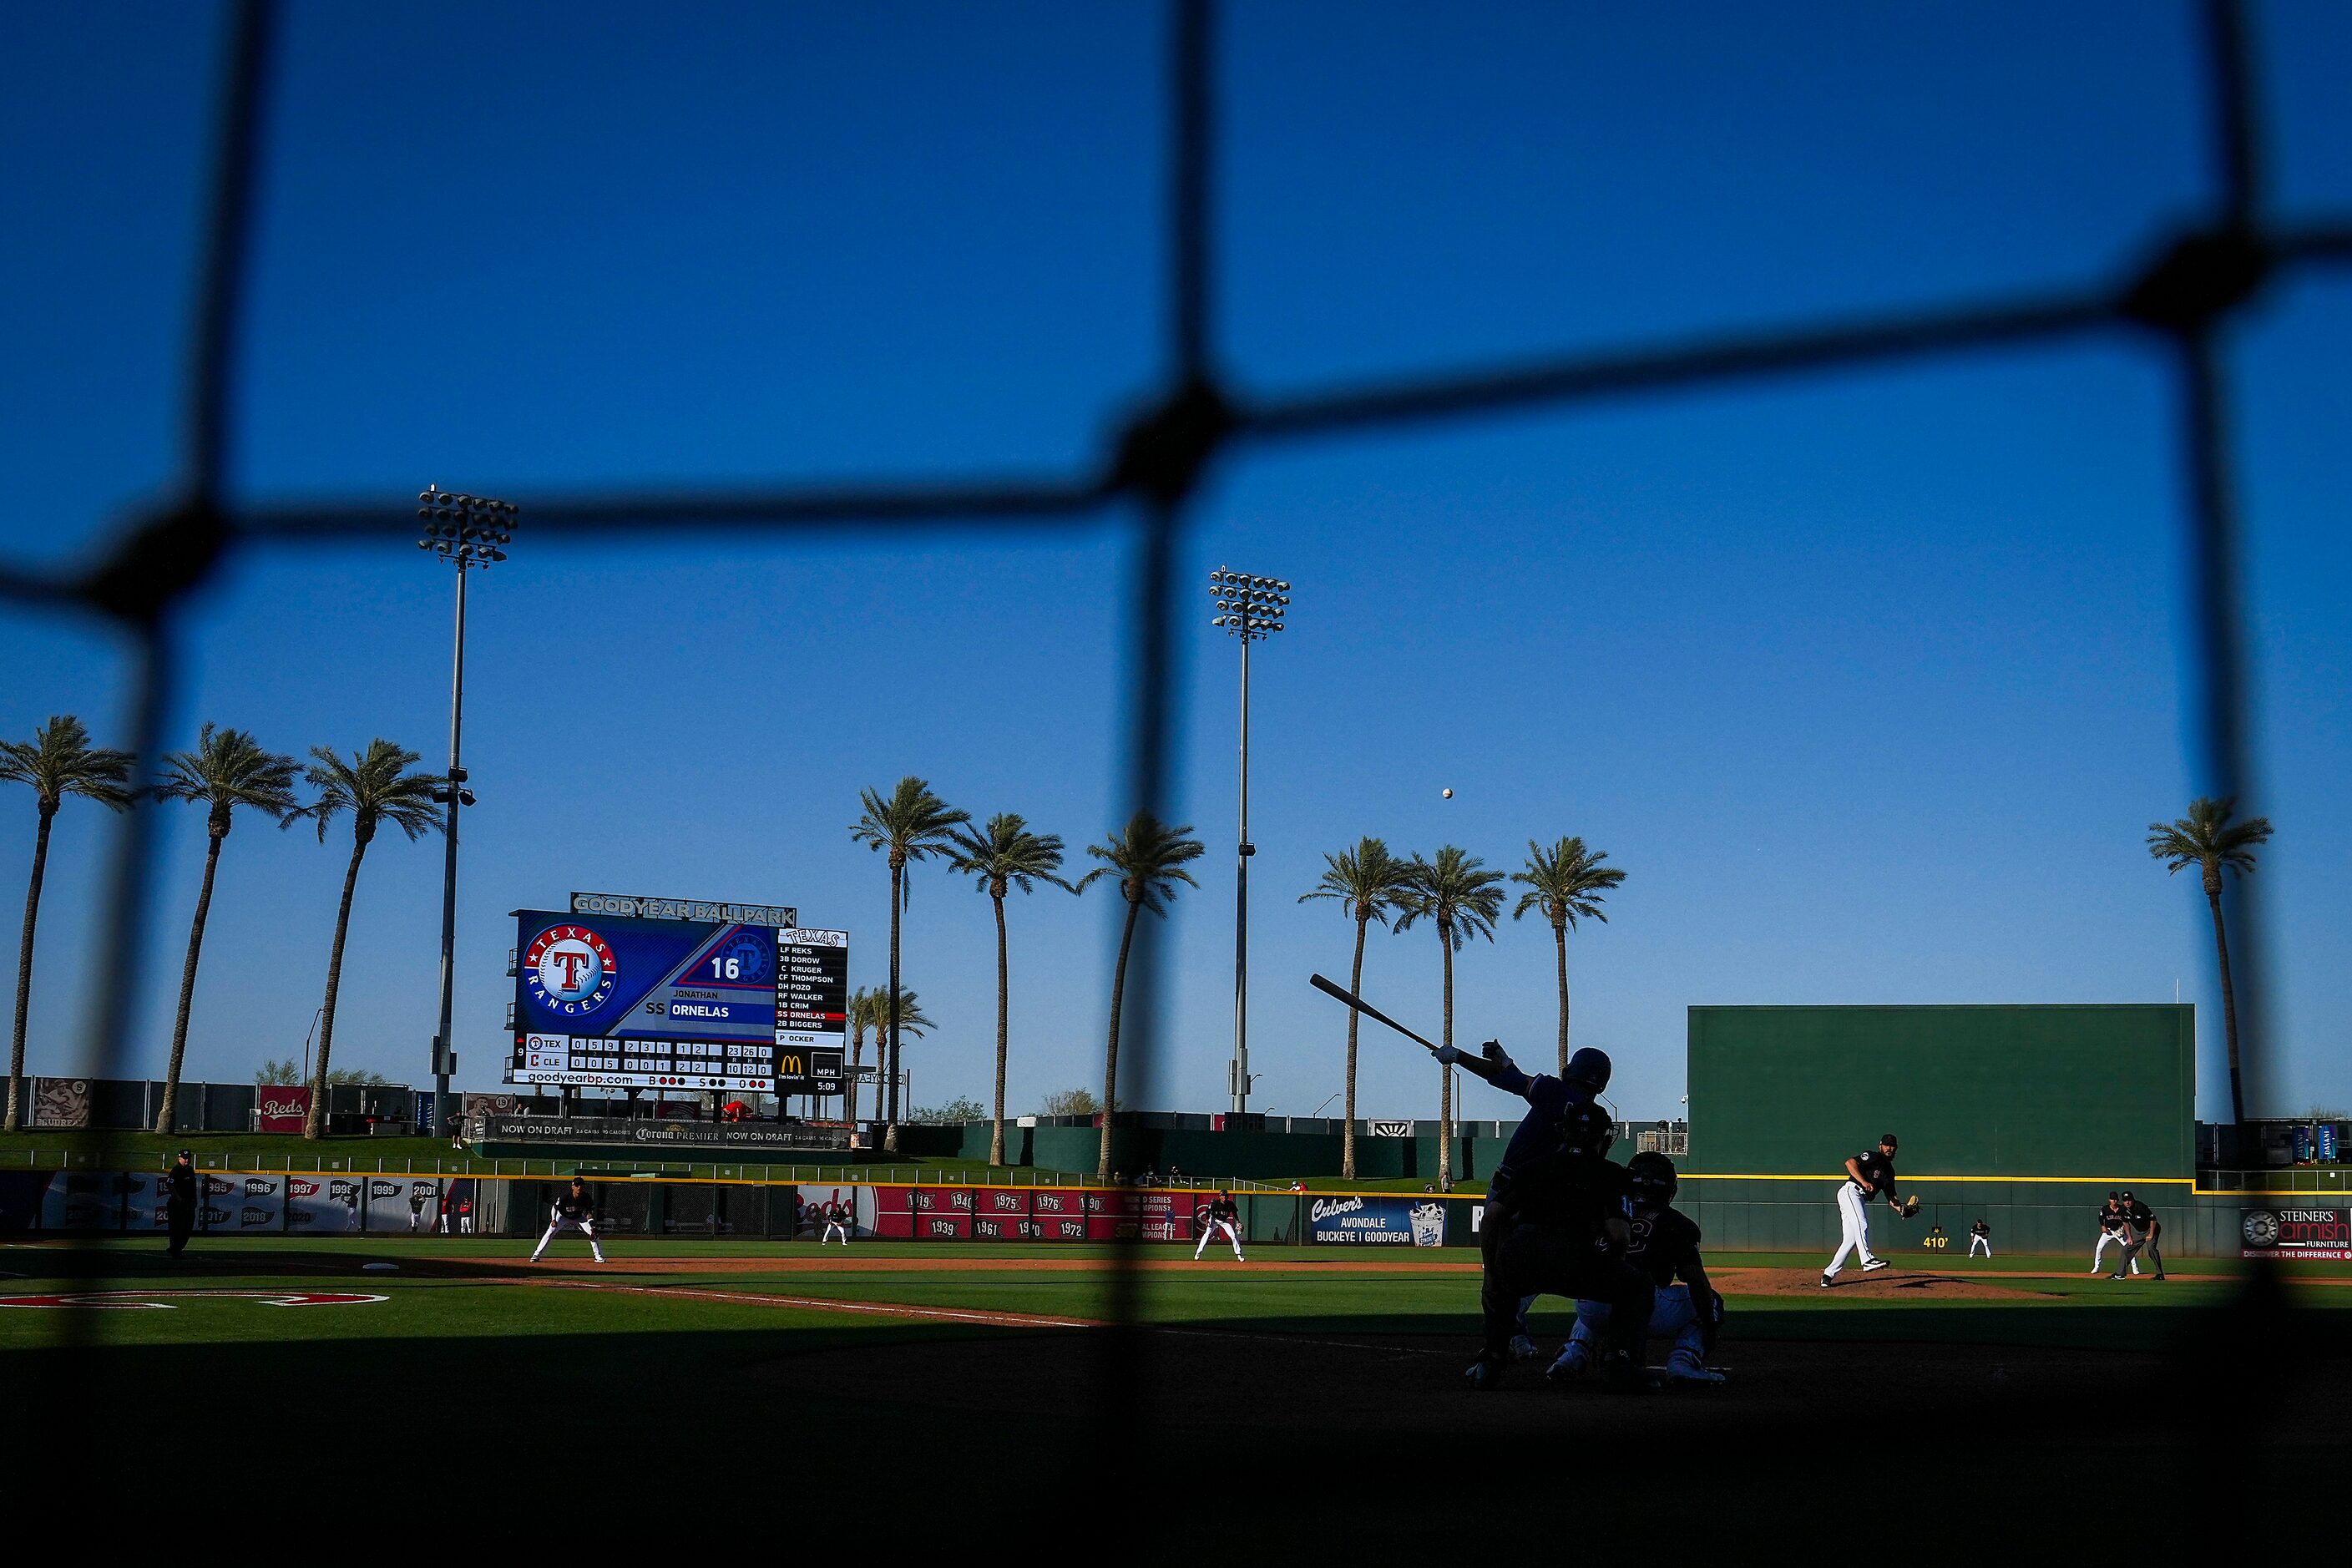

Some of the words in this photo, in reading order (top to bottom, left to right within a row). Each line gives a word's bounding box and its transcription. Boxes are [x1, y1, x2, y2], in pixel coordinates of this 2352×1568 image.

[574, 897, 689, 918] GOODYEAR
[695, 905, 794, 924] BALLPARK
[536, 928, 605, 953] TEXAS
[786, 929, 840, 947] TEXAS
[554, 952, 588, 991] T
[712, 957, 739, 979] 16
[791, 966, 822, 974] KRUGER
[791, 975, 833, 984] THOMPSON
[528, 975, 611, 1014] RANGERS
[674, 990, 718, 999] JONATHAN
[645, 1002, 665, 1015] SS
[672, 1004, 729, 1018] ORNELAS
[518, 1048, 524, 1056] 9
[575, 1040, 580, 1049] 0
[628, 1043, 634, 1051] 2
[661, 1044, 665, 1053] 1
[591, 1060, 596, 1068] 0
[660, 1062, 665, 1070] 1
[529, 1072, 633, 1085] goodyearbp.com
[649, 1076, 656, 1085] B
[699, 1078, 706, 1087] S
[817, 1082, 836, 1090] 5:09
[263, 1099, 305, 1115] Reds
[502, 1125, 524, 1134] NOW
[527, 1125, 542, 1134] ON
[544, 1125, 573, 1136] DRAFT
[635, 1127, 674, 1141] Corona
[677, 1132, 719, 1141] PREMIER
[751, 1132, 763, 1141] ON
[766, 1133, 792, 1141] DRAFT
[207, 1183, 227, 1192] 995
[245, 1183, 271, 1193] 1996
[289, 1184, 312, 1194] 1997
[373, 1186, 395, 1195] 1999
[414, 1186, 436, 1196] 2001
[908, 1194, 929, 1208] 119
[996, 1195, 1016, 1209] 1975
[1039, 1196, 1059, 1210] 1976
[1080, 1197, 1100, 1211] 190
[1311, 1196, 1363, 1222] Culver's
[207, 1211, 225, 1221] 017
[243, 1211, 266, 1222] 2018
[2280, 1211, 2334, 1222] STEINER'S
[932, 1221, 953, 1236] 1939
[1341, 1217, 1386, 1228] AVONDALE
[2279, 1211, 2349, 1239] amish
[977, 1222, 997, 1236] 1961
[1061, 1222, 1081, 1237] 1972
[1317, 1231, 1356, 1242] BUCKEYE
[1364, 1232, 1410, 1243] GOODYEAR
[1924, 1237, 1949, 1248] 410'
[2306, 1241, 2349, 1249] FURNITURE
